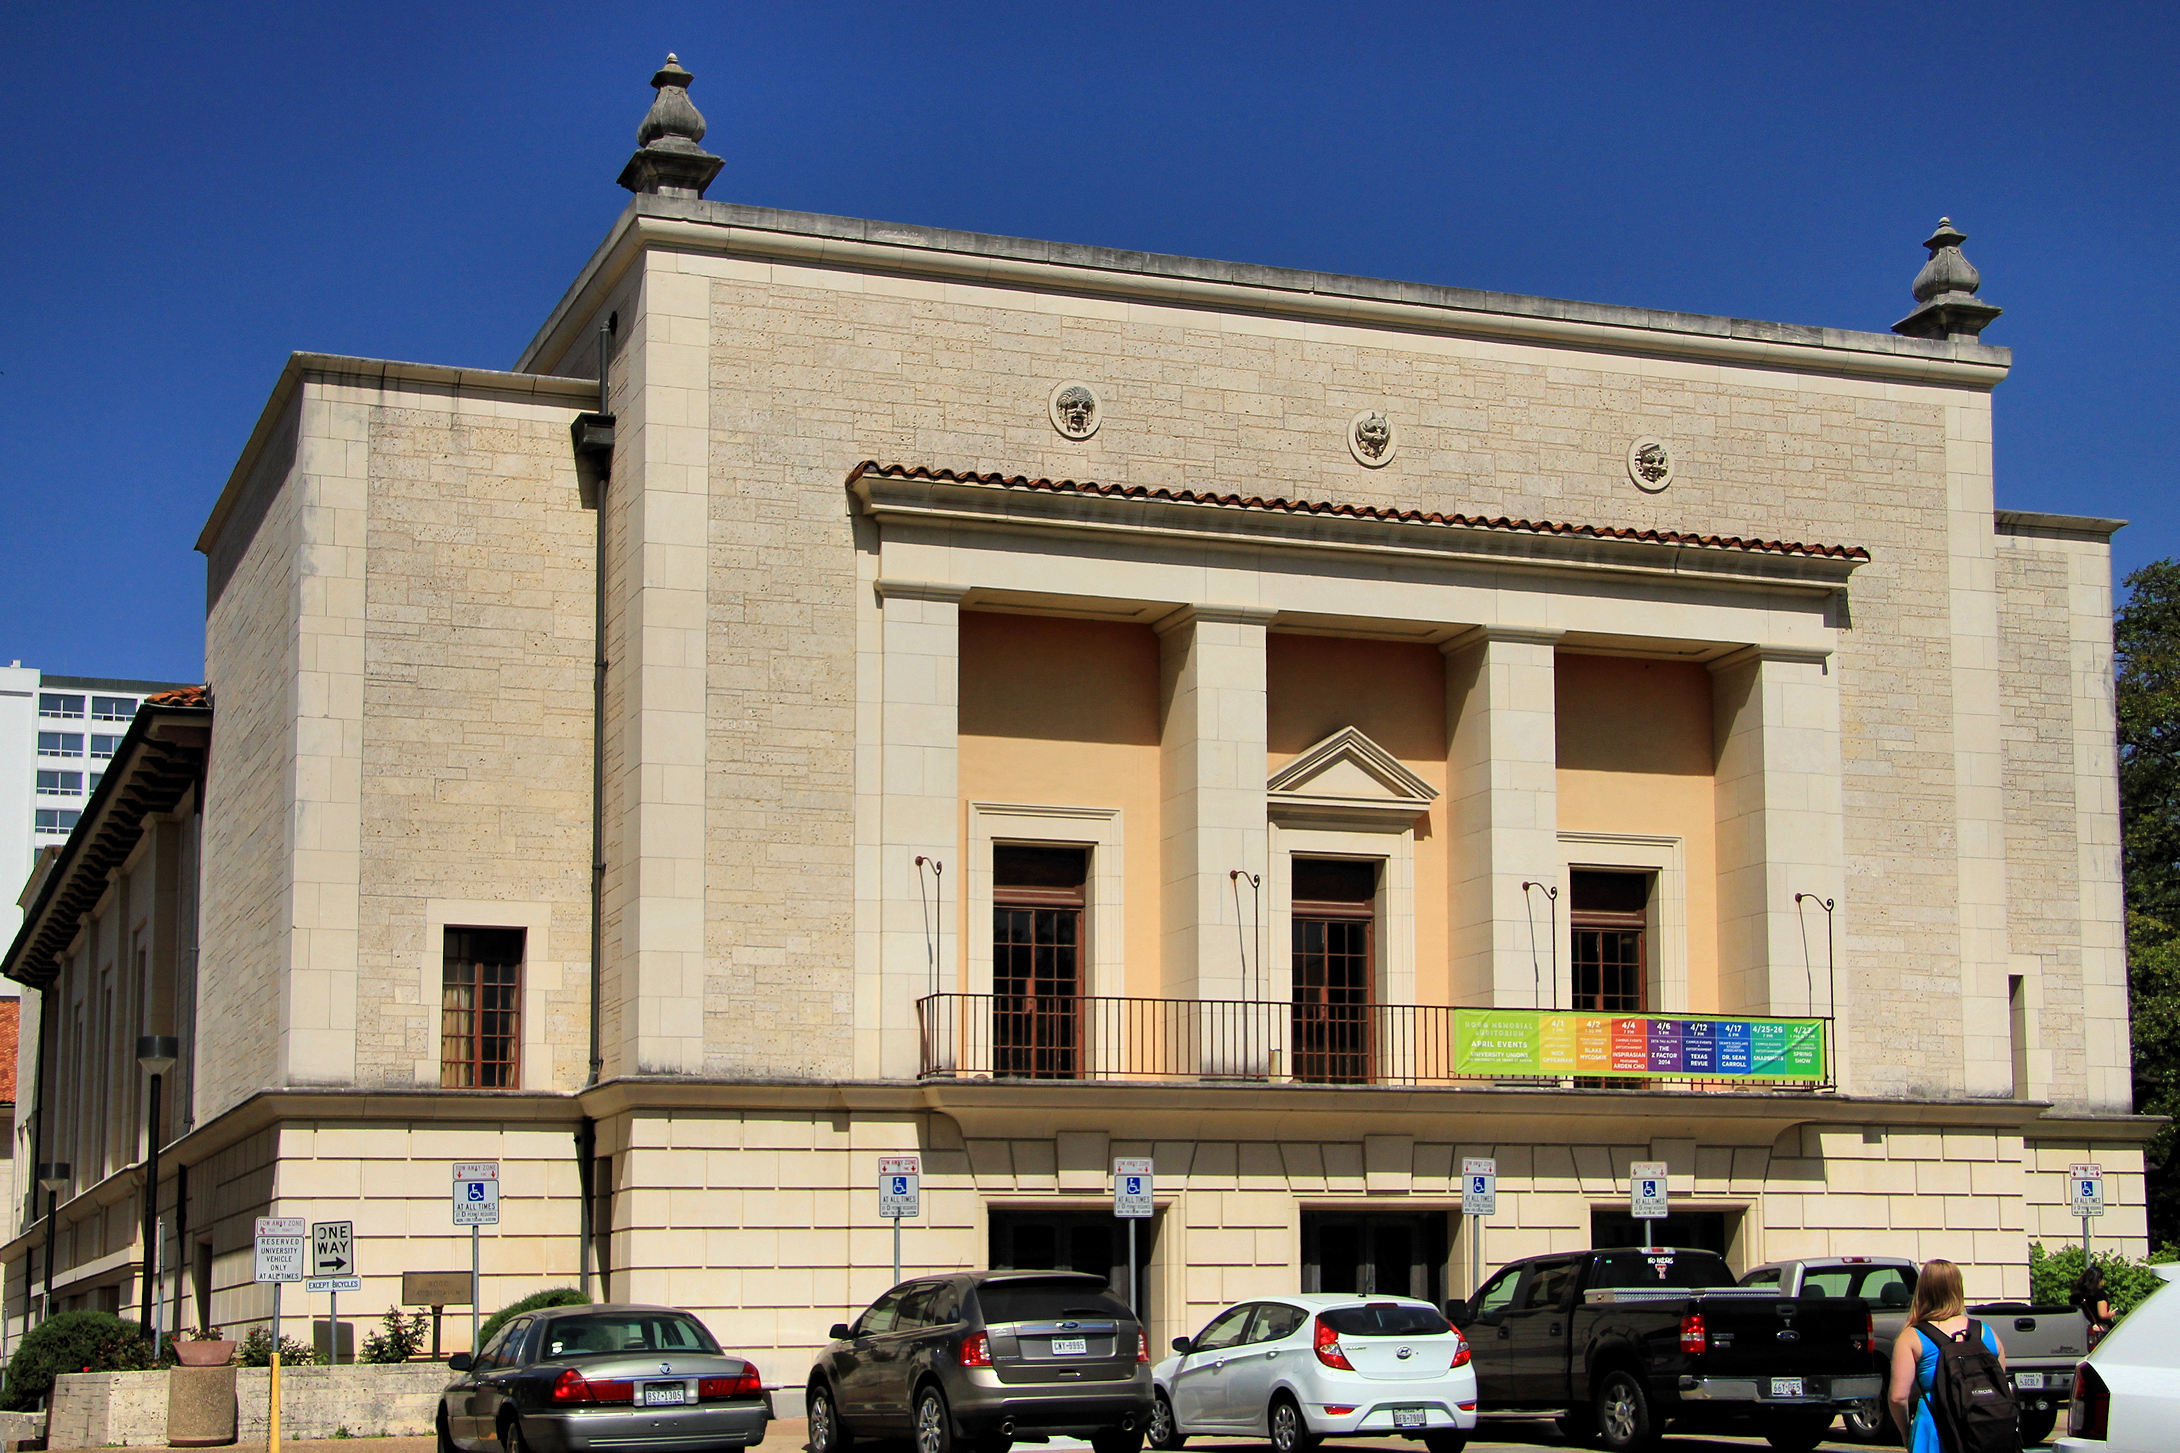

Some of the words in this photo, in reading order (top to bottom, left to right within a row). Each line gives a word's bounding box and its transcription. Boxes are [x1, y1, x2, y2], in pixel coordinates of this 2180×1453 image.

[1492, 1022, 1533, 1030] MEMORIAL
[1586, 1020, 1601, 1028] 4/2
[1621, 1021, 1636, 1030] 4/4
[1656, 1022, 1671, 1030] 4/6
[1690, 1024, 1708, 1032] 4/12
[1725, 1024, 1742, 1032] 4/17
[1752, 1025, 1783, 1034] 4/25-26
[1471, 1040, 1495, 1048] APRIL
[318, 1226, 348, 1240] ONE
[318, 1241, 348, 1254] WAY
[332, 1280, 358, 1288] BICYCLES
